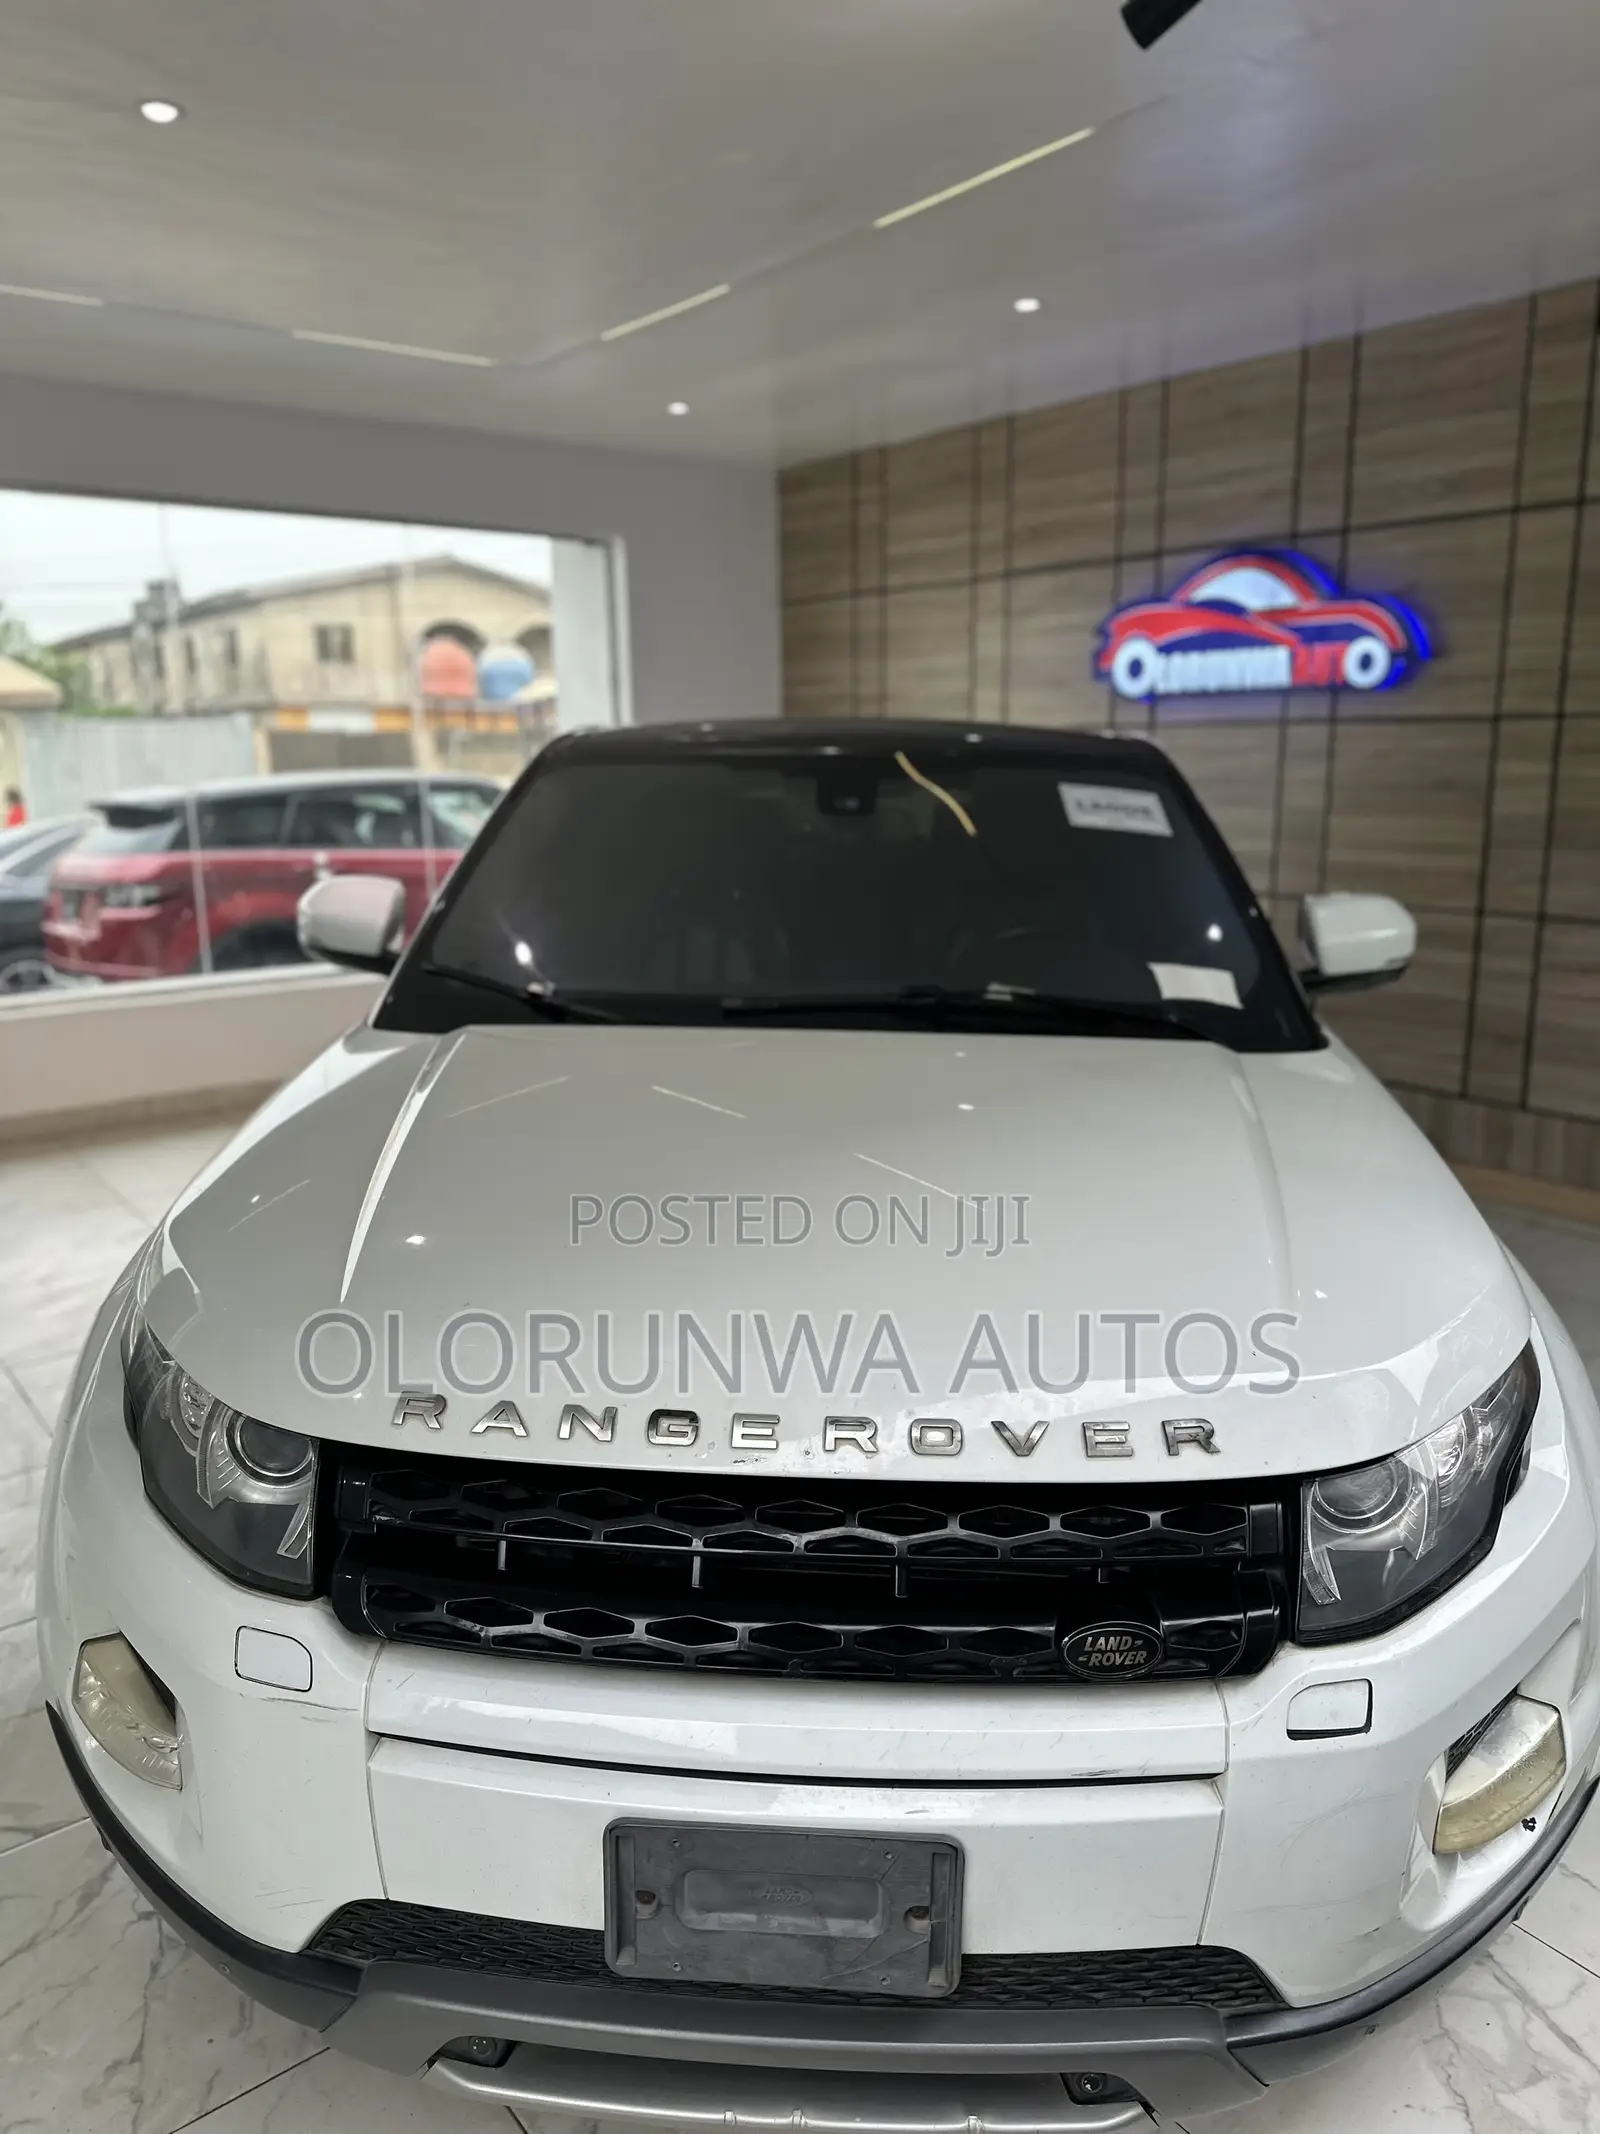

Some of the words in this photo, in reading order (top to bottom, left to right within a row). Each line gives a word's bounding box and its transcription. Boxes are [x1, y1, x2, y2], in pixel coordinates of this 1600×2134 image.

[392, 1389, 781, 1452] RANGE
[822, 1414, 1222, 1459] ROVER
[1084, 1635, 1133, 1651] LAND
[1088, 1650, 1148, 1667] ROVER
